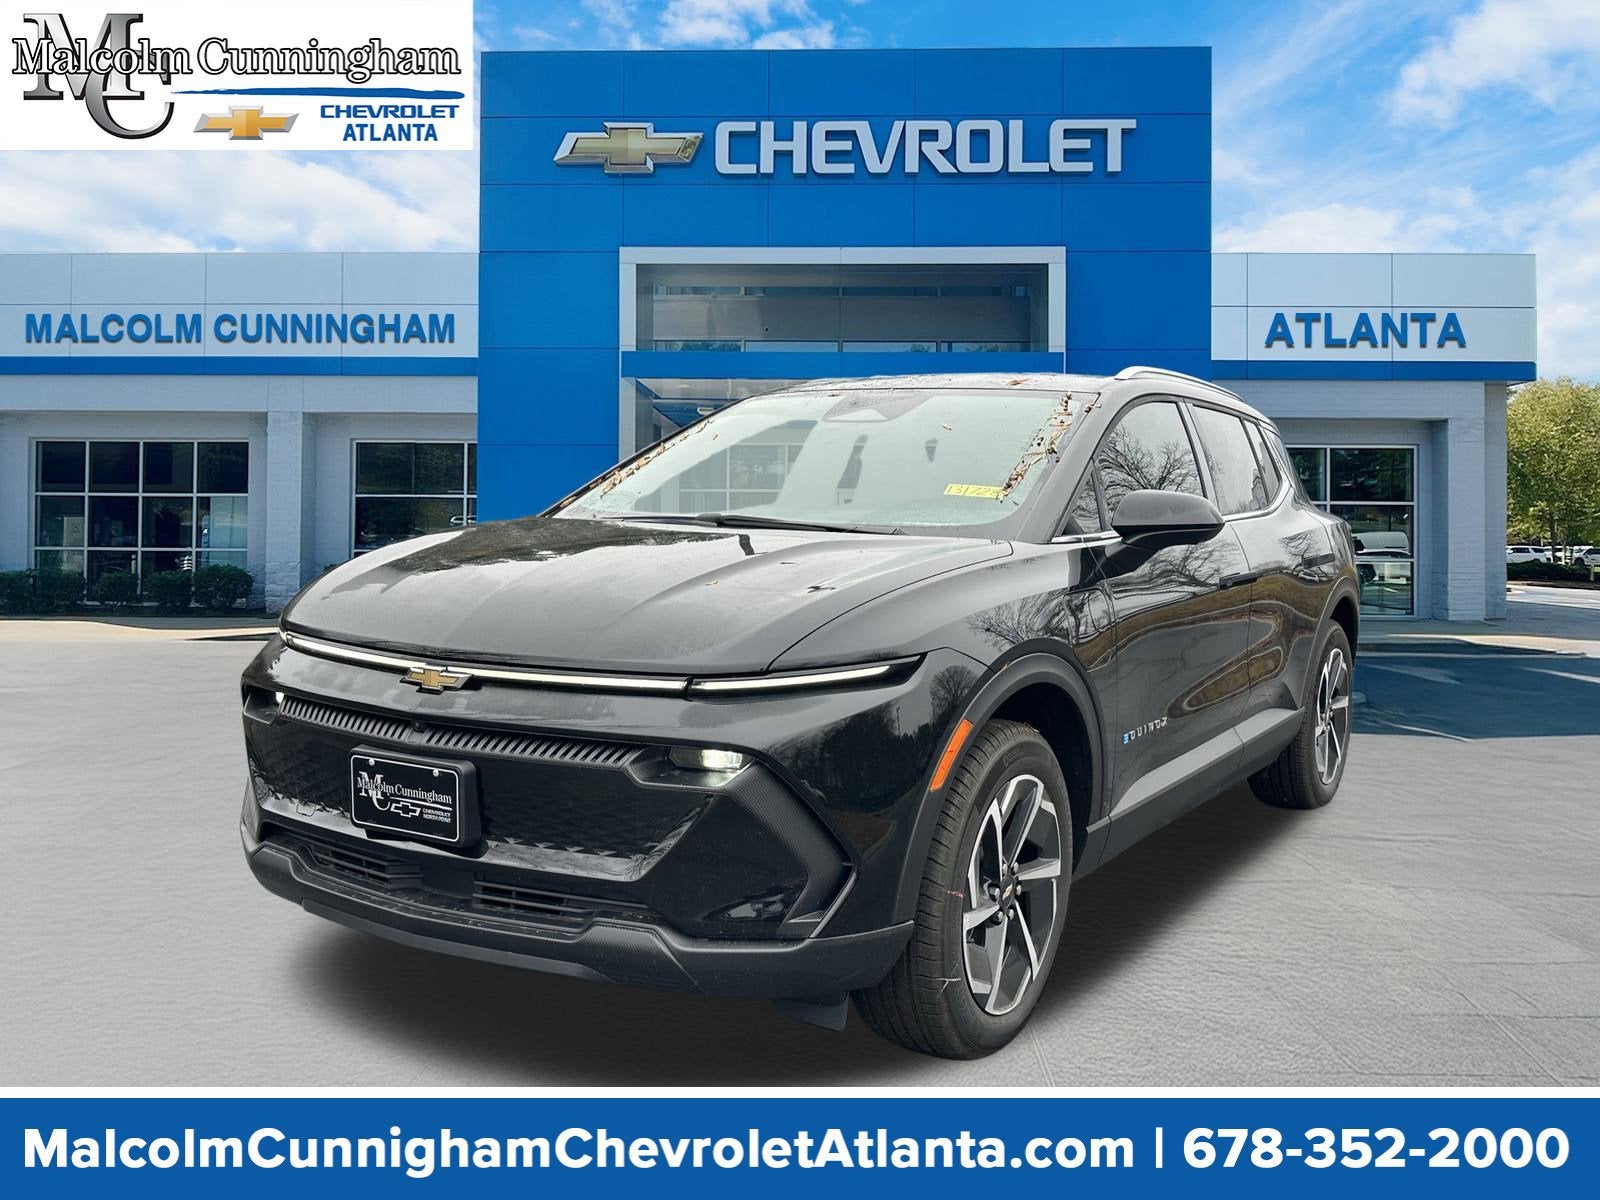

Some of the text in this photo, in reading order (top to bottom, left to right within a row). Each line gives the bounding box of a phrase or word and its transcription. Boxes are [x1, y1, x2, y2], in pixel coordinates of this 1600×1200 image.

[715, 119, 1136, 174] CHEVROLET
[25, 314, 455, 343] MALCOLM CUNNINGHAM
[1265, 313, 1467, 348] ATLANTA
[1123, 716, 1167, 744] EQUINOX
[357, 776, 452, 804] Malcolm Cunningham
